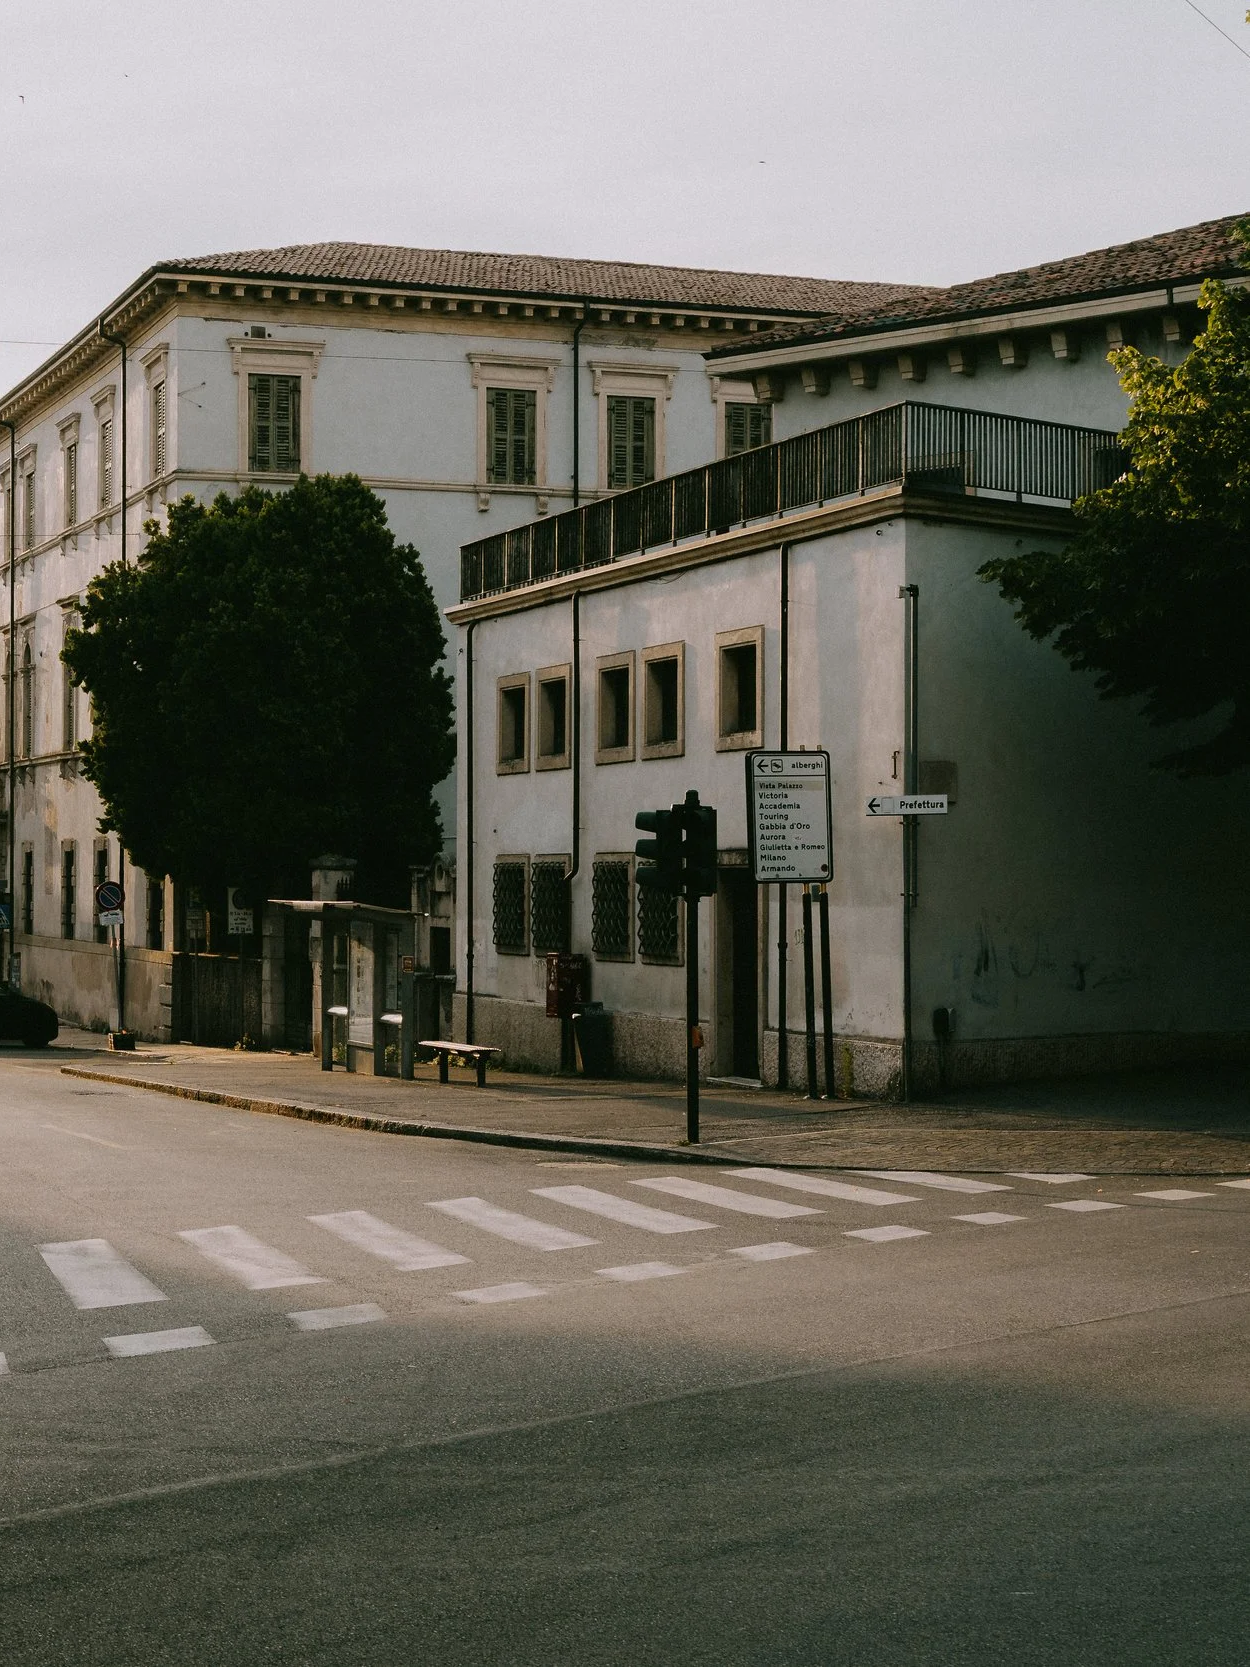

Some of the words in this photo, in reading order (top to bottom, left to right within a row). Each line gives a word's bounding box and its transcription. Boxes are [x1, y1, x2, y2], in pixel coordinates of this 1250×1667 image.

[791, 760, 823, 770] alberghi
[759, 802, 801, 810] Accademia
[899, 800, 945, 810] Prefettura
[759, 813, 789, 821] Touring
